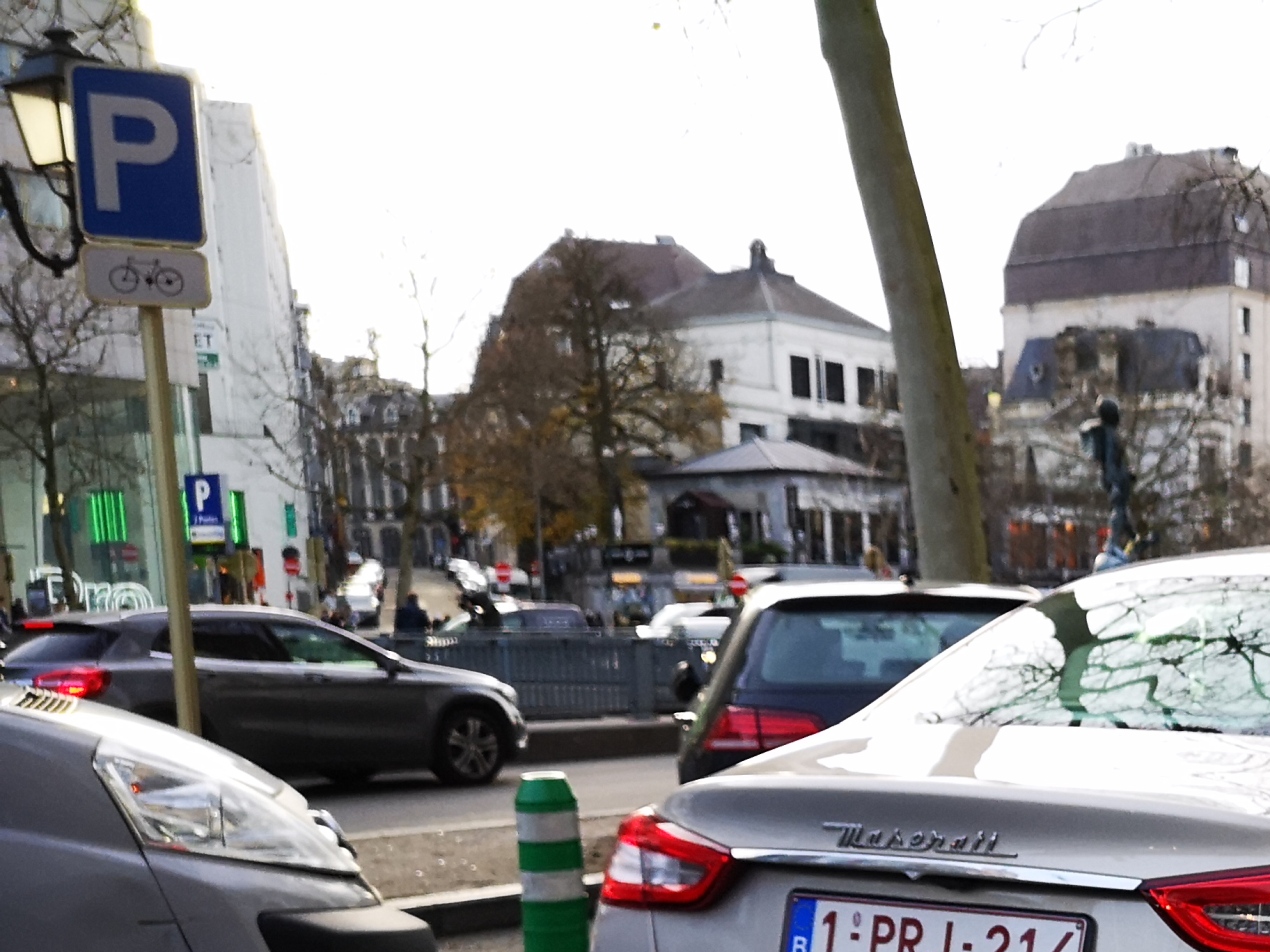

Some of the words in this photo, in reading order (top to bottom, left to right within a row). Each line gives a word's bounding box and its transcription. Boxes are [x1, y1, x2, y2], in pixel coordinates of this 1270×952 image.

[87, 92, 179, 213] P
[194, 478, 211, 513] P
[822, 821, 1018, 859] Maserati
